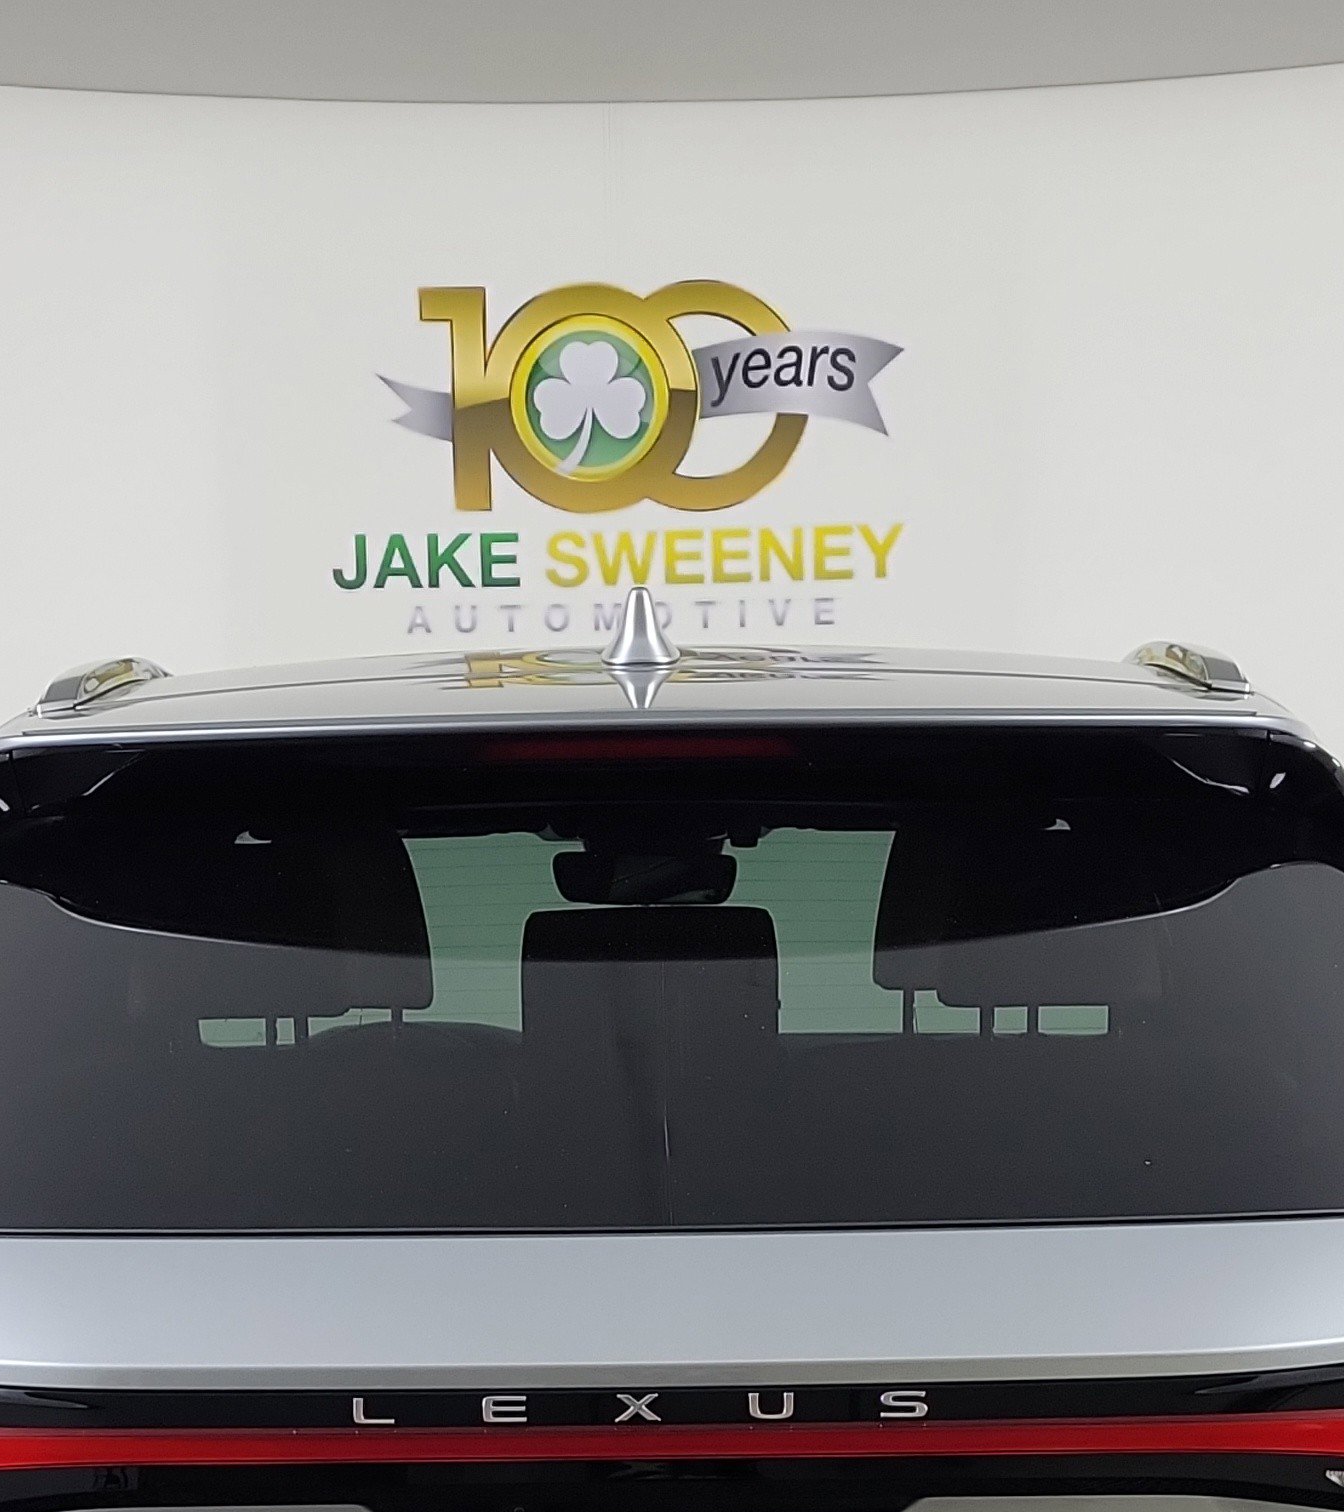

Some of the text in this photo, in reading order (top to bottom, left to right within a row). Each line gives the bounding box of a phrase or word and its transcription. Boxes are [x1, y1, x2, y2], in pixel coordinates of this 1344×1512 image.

[418, 279, 858, 515] 100 years
[332, 523, 904, 591] JAKE SWEENEY
[353, 1391, 928, 1424] LEXUS
